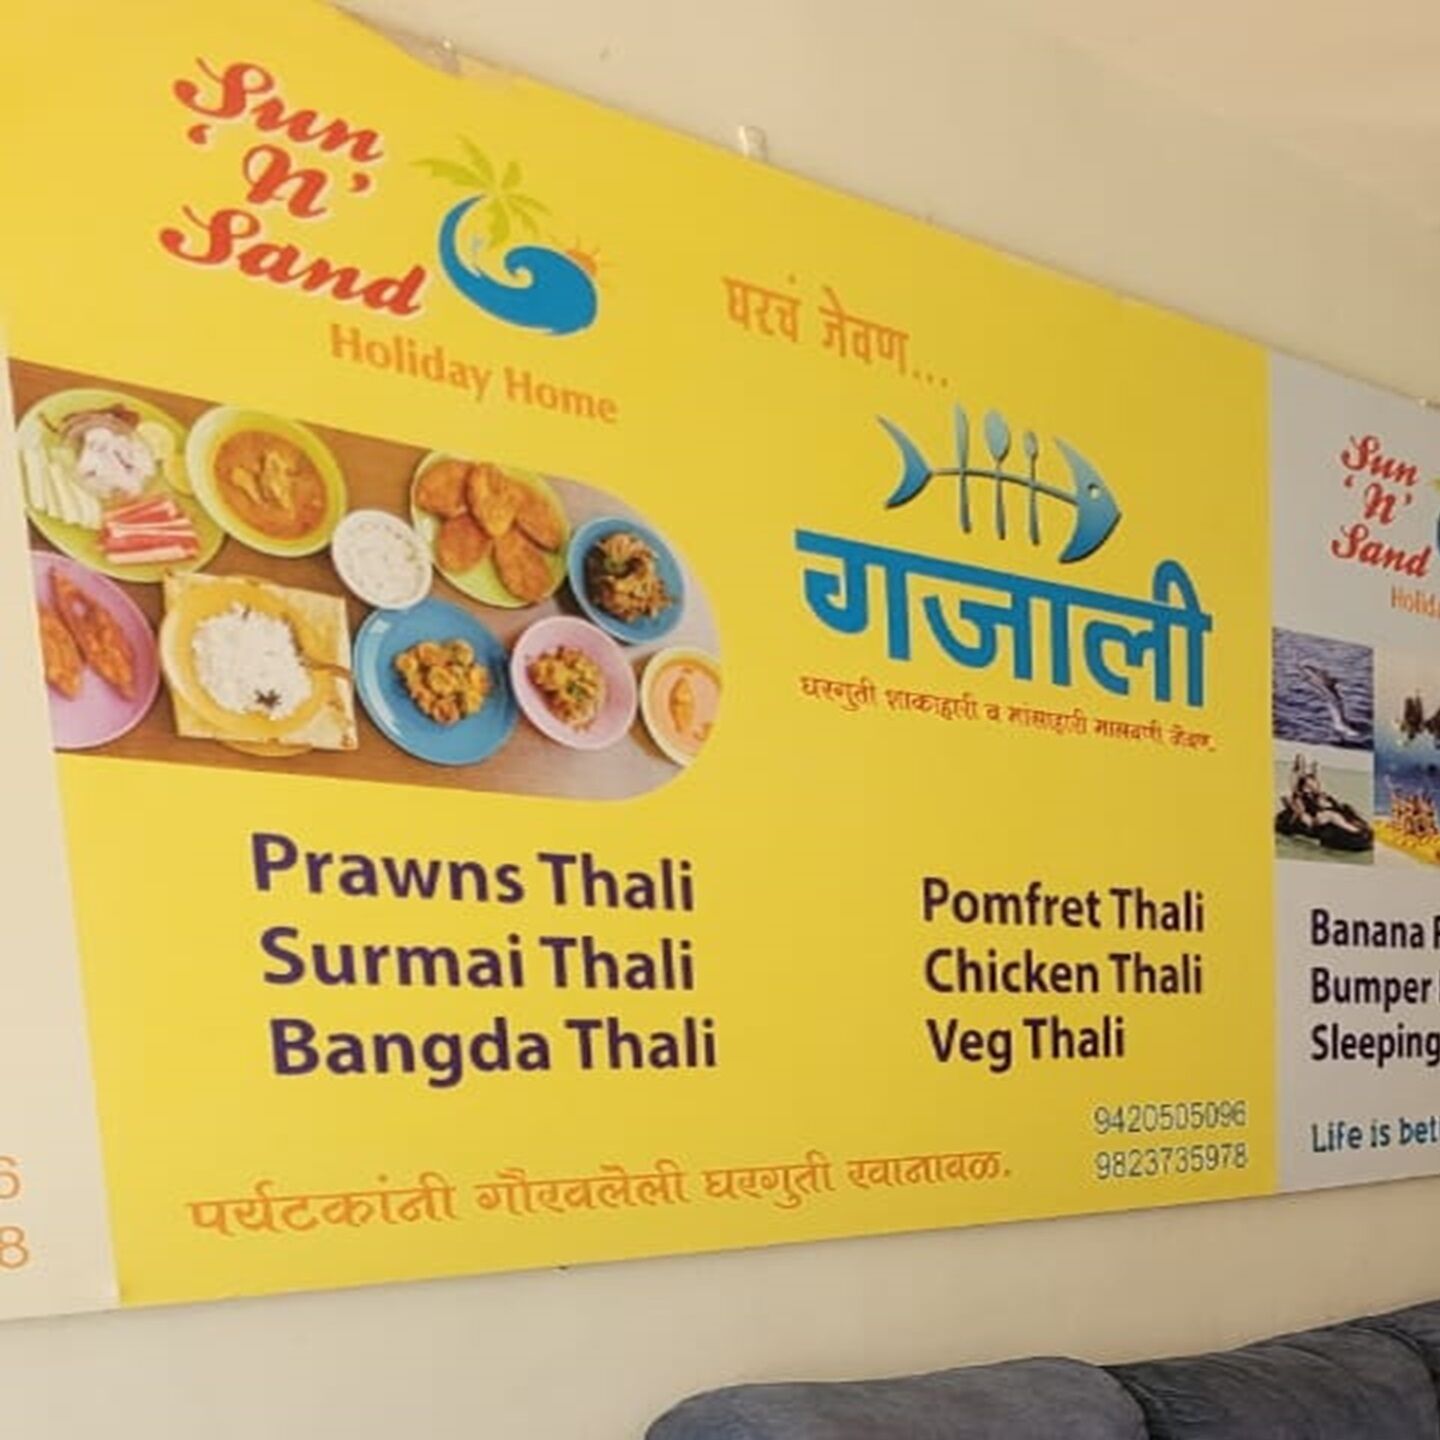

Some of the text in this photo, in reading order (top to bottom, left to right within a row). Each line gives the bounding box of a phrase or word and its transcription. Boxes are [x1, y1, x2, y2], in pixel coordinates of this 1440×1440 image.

[173, 57, 383, 162] Sun
[158, 205, 427, 316] Sand
[723, 274, 802, 343] घरचं
[330, 323, 618, 424] Holiday Home
[1340, 435, 1419, 486] Sun
[1331, 524, 1432, 577] Sand
[795, 529, 1212, 708] गजाली
[801, 676, 876, 711] घरगुती
[885, 691, 979, 721] शाकाहारी
[984, 703, 1000, 720] व
[251, 832, 694, 912] Prawns Thali
[923, 877, 1204, 932] Pomfret Thali
[1311, 909, 1424, 949] Banana
[260, 926, 694, 990] Surmai Thali
[924, 948, 1202, 995] Chicken Thali
[1311, 968, 1431, 1012] Bumper
[270, 1017, 717, 1089] Bangda Thali
[926, 1016, 1125, 1073] Veg Thali
[1094, 1101, 1246, 1134] 9420505096
[1311, 1120, 1362, 1153] Life
[1370, 1119, 1390, 1148] is
[1094, 1143, 1247, 1180] 9823735978
[187, 1172, 458, 1236] पर्यटकांनी
[474, 1159, 689, 1214] गौरवलेली
[701, 1150, 835, 1209] घरगुती
